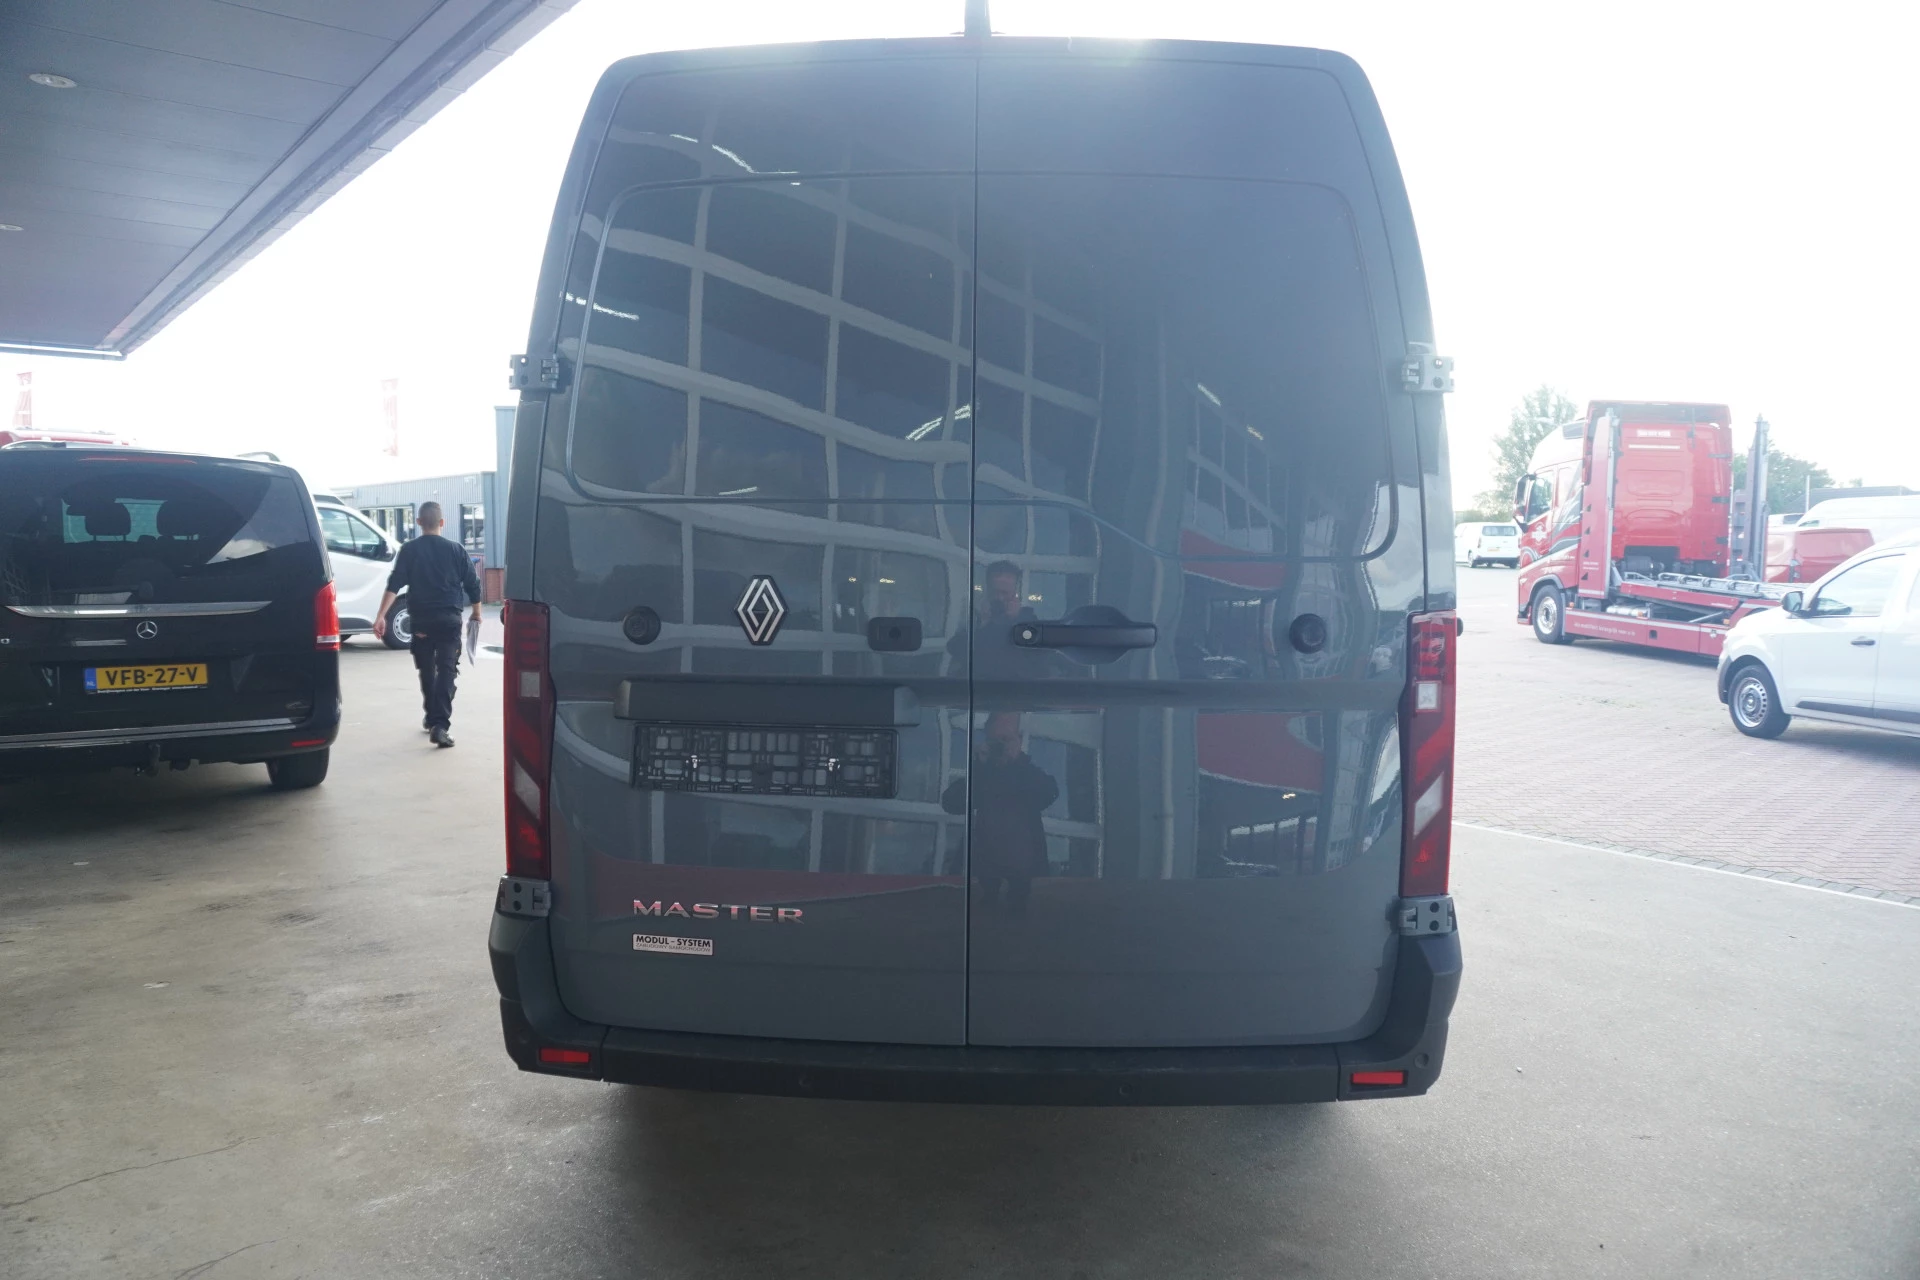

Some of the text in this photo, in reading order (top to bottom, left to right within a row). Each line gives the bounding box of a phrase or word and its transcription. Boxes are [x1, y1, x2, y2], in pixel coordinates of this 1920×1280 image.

[105, 666, 198, 686] VFB-27-V
[633, 899, 805, 924] MASTER
[636, 936, 670, 945] MODUL
[677, 939, 711, 948] SYSTEM
